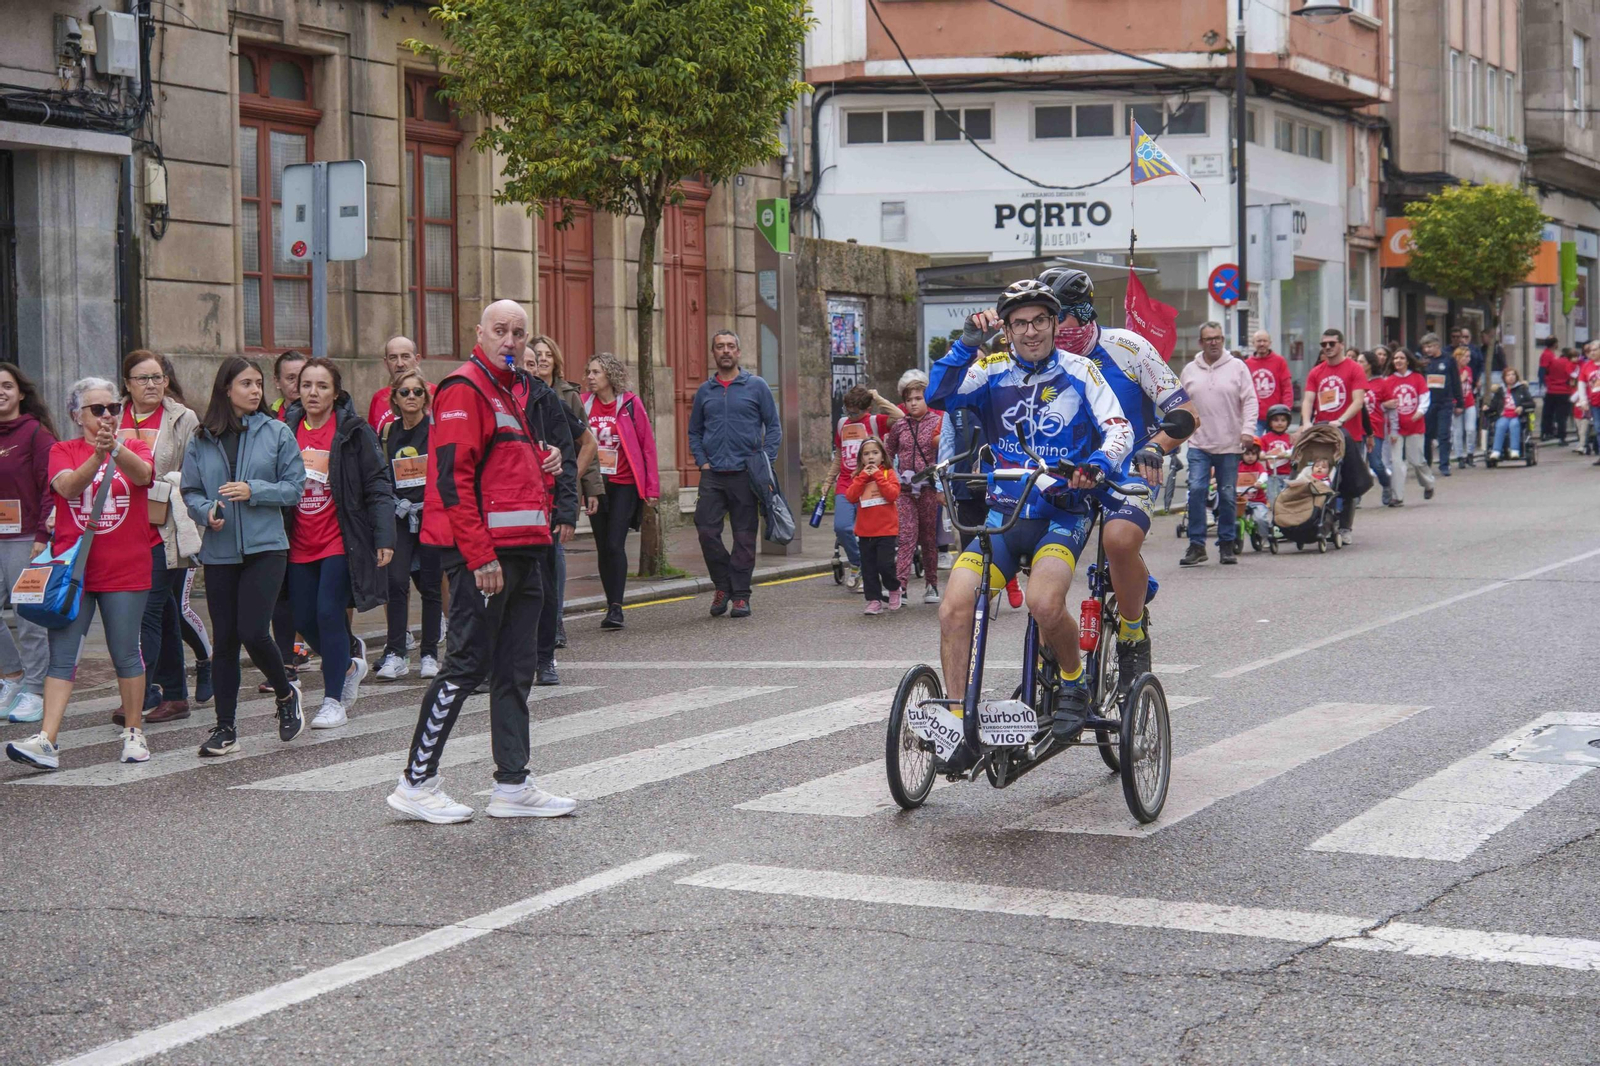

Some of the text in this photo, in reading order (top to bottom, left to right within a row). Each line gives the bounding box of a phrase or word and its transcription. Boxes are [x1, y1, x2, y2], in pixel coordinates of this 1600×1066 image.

[995, 201, 1112, 229] PORTO
[1022, 231, 1087, 246] PAADEROS
[1118, 337, 1140, 352] RODOSA
[1142, 358, 1158, 386] GRANISA
[998, 437, 1069, 458] DisCmino
[968, 620, 980, 685] ROCINANTE
[990, 733, 1026, 744] VIGO
